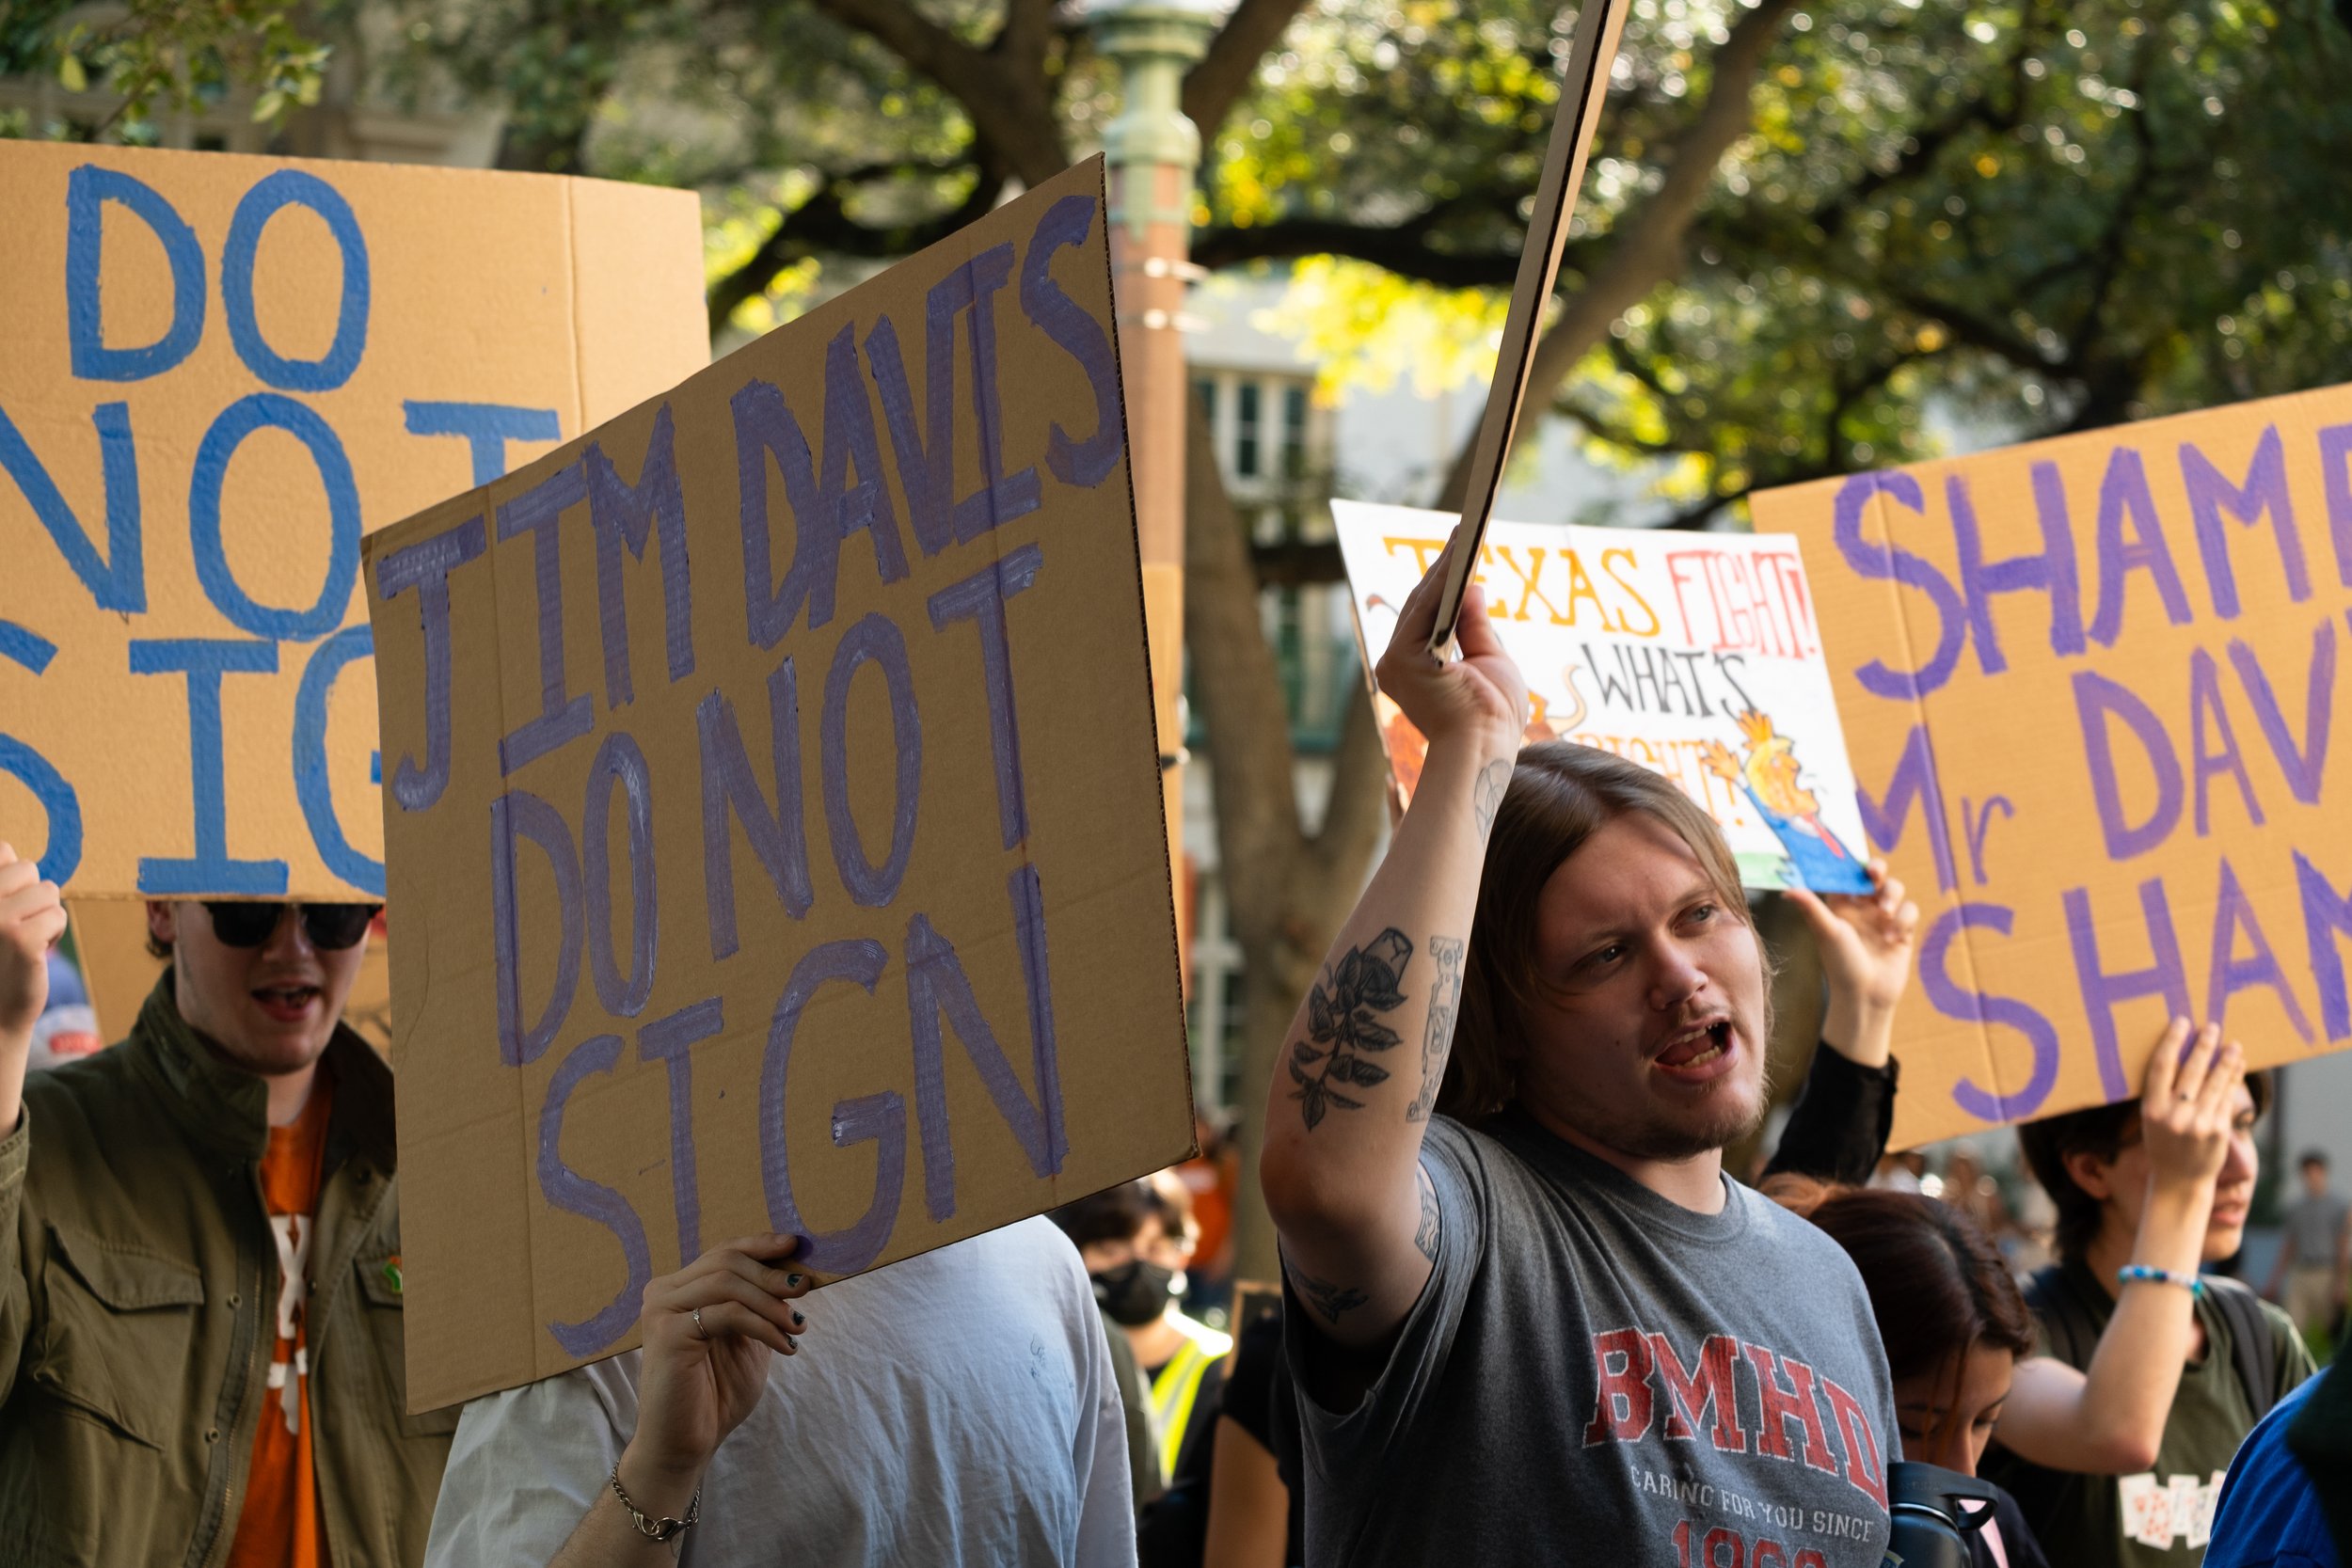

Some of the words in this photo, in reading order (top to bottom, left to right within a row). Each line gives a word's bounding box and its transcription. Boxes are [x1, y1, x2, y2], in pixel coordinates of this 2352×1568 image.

[66, 164, 372, 393] DO
[377, 401, 695, 812] JIM
[730, 196, 1127, 652] DAVIS
[1666, 549, 1819, 660] FIGHT!
[1581, 642, 1756, 720] WHAT'S
[1856, 721, 2018, 895] Mr
[2072, 607, 2352, 863] DAV
[490, 731, 659, 1067] DO
[695, 542, 1043, 961] NOT
[537, 863, 1070, 1359] SIGN
[1581, 1324, 1889, 1514] BMHD
[1630, 1464, 1715, 1507] CARING
[1721, 1489, 1756, 1520] FOR
[1758, 1502, 1804, 1531] YOU
[1813, 1509, 1875, 1544] SINCE
